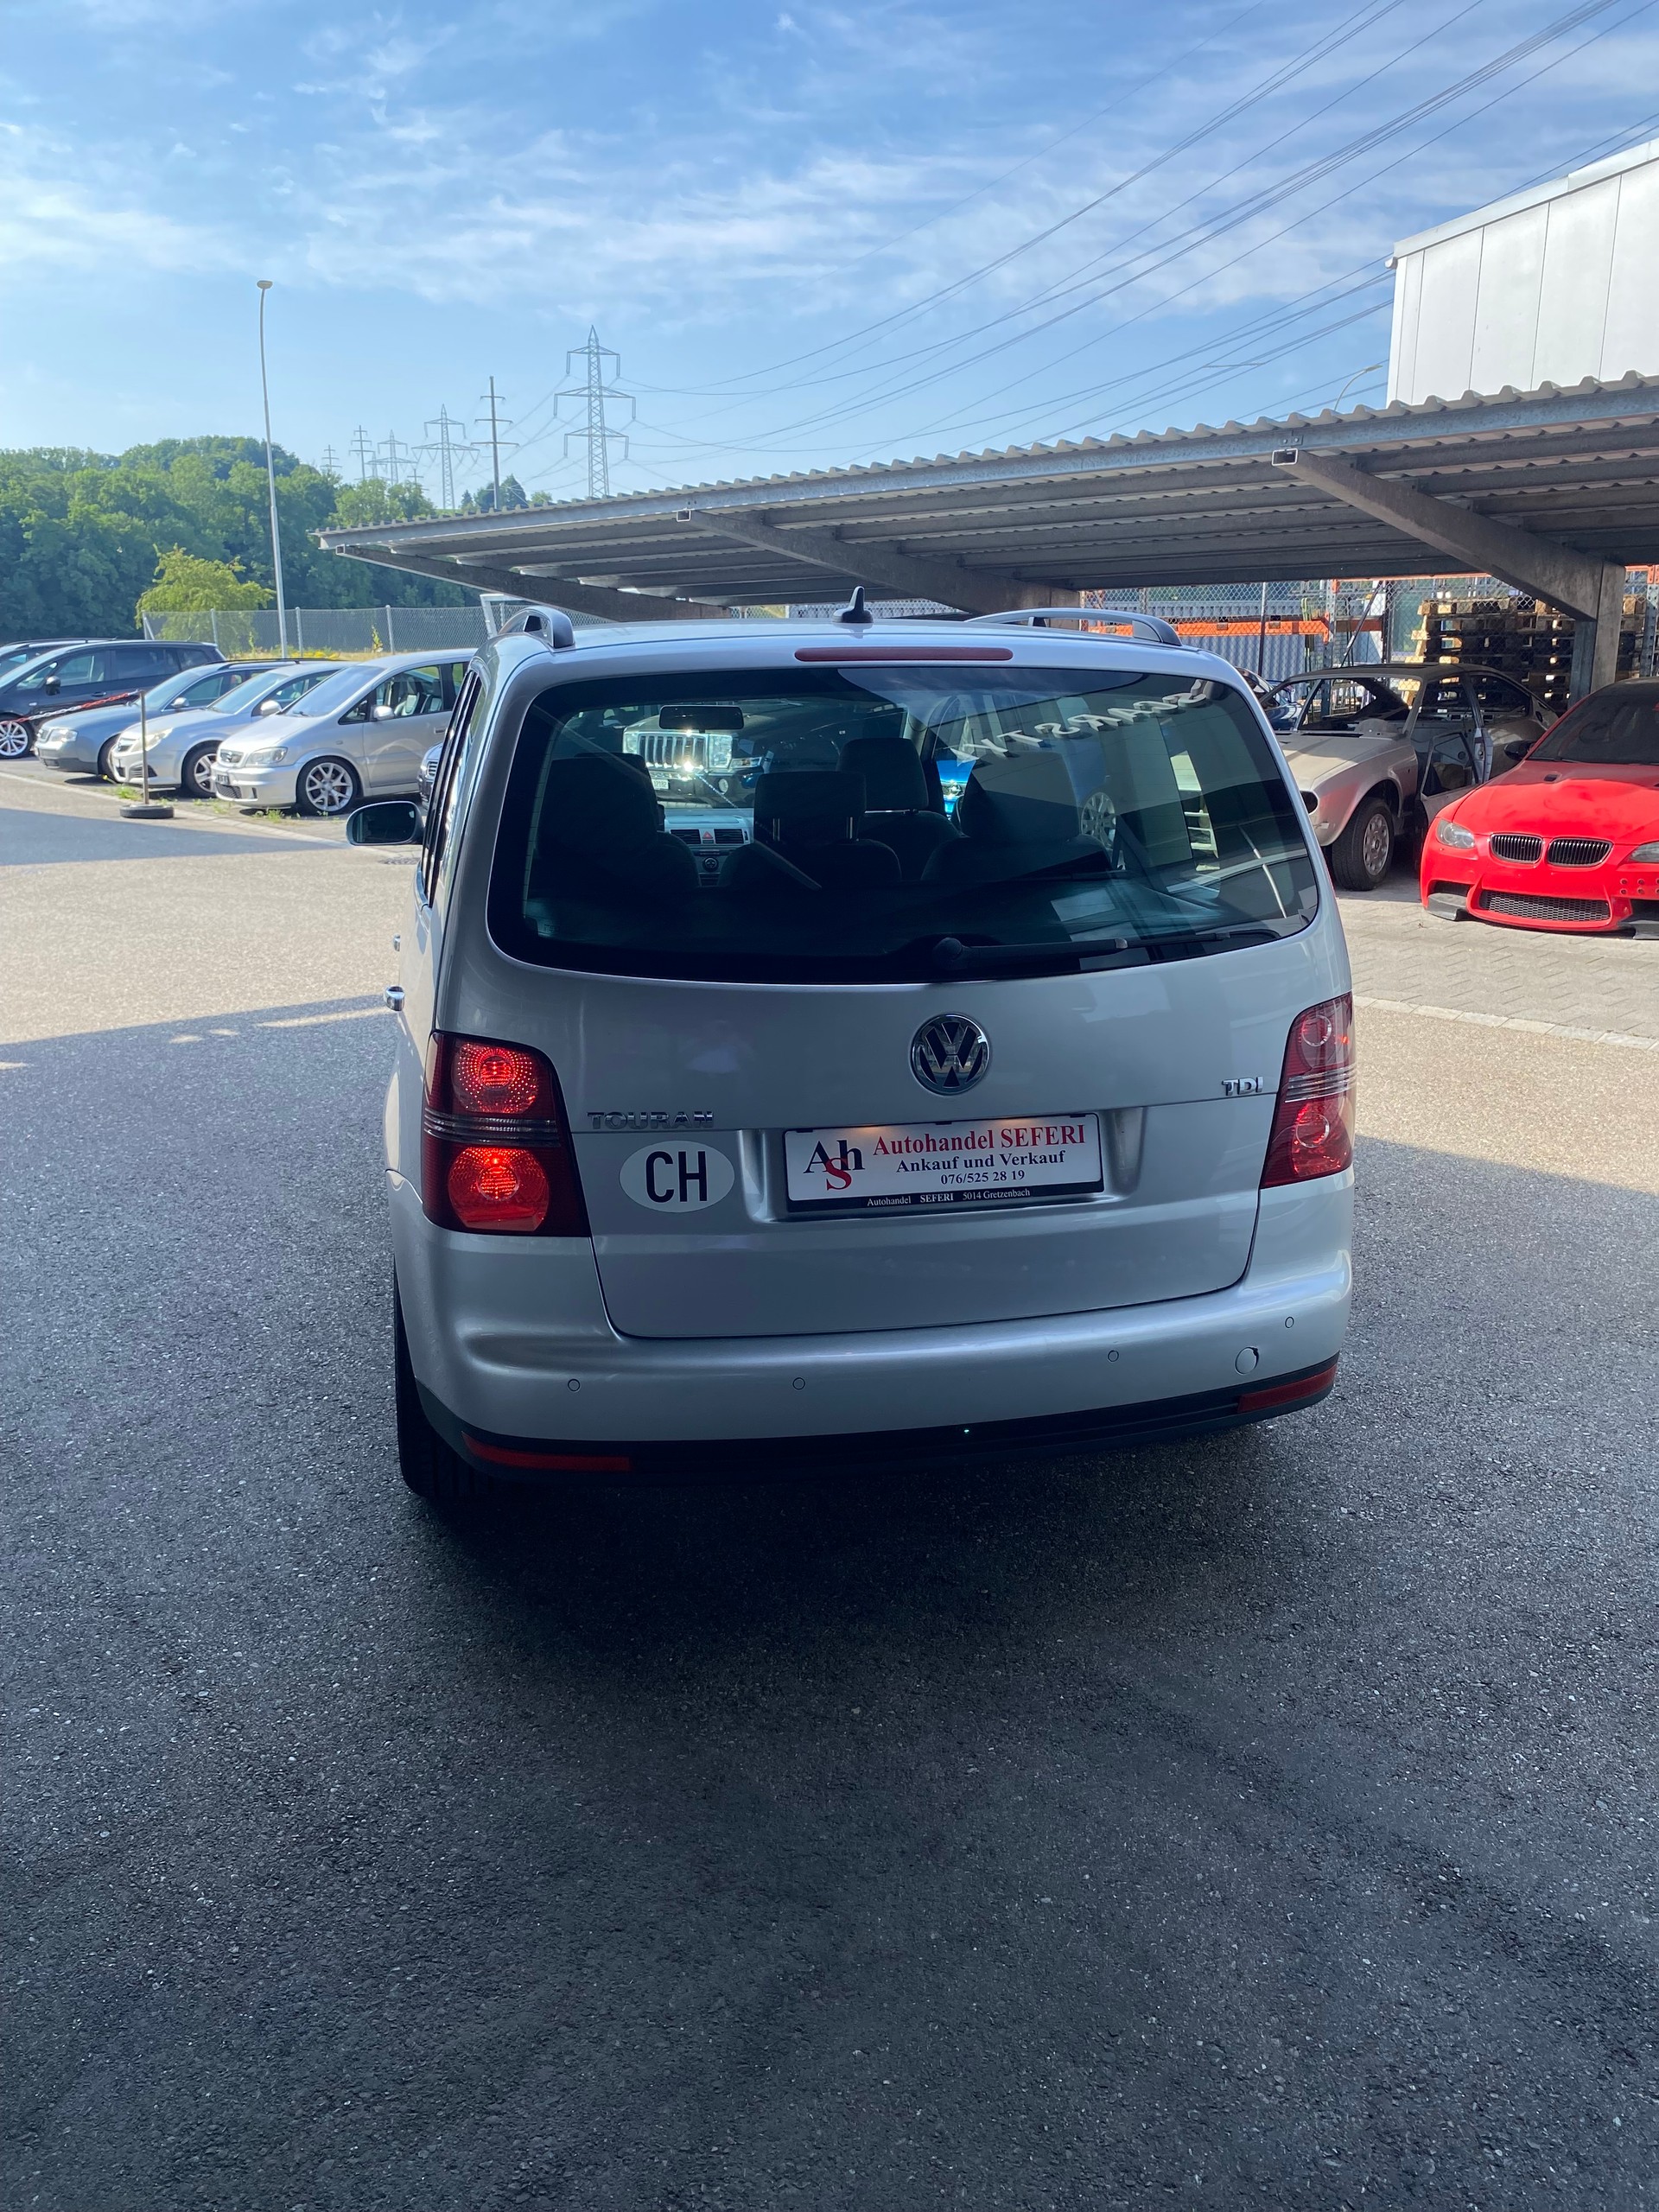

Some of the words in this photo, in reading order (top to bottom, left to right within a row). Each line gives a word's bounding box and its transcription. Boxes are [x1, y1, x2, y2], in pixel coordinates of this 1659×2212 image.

[912, 1014, 988, 1095] VW
[1222, 1076, 1264, 1096] TDI
[587, 1111, 715, 1129] TOURAN
[873, 1129, 995, 1156] Autohandel
[1001, 1124, 1085, 1148] SEFERI
[896, 1156, 960, 1173] Ankauf
[963, 1154, 994, 1170] und
[999, 1150, 1065, 1166] Verkauf
[645, 1150, 708, 1203] CH
[940, 1172, 989, 1185] 076/525
[993, 1171, 1007, 1182] 28
[1011, 1169, 1025, 1180] 19
[867, 1195, 912, 1207] Autohandel
[919, 1193, 954, 1204] SEFERI
[962, 1192, 982, 1201] 5014
[982, 1188, 1031, 1199] Gretzenbach
